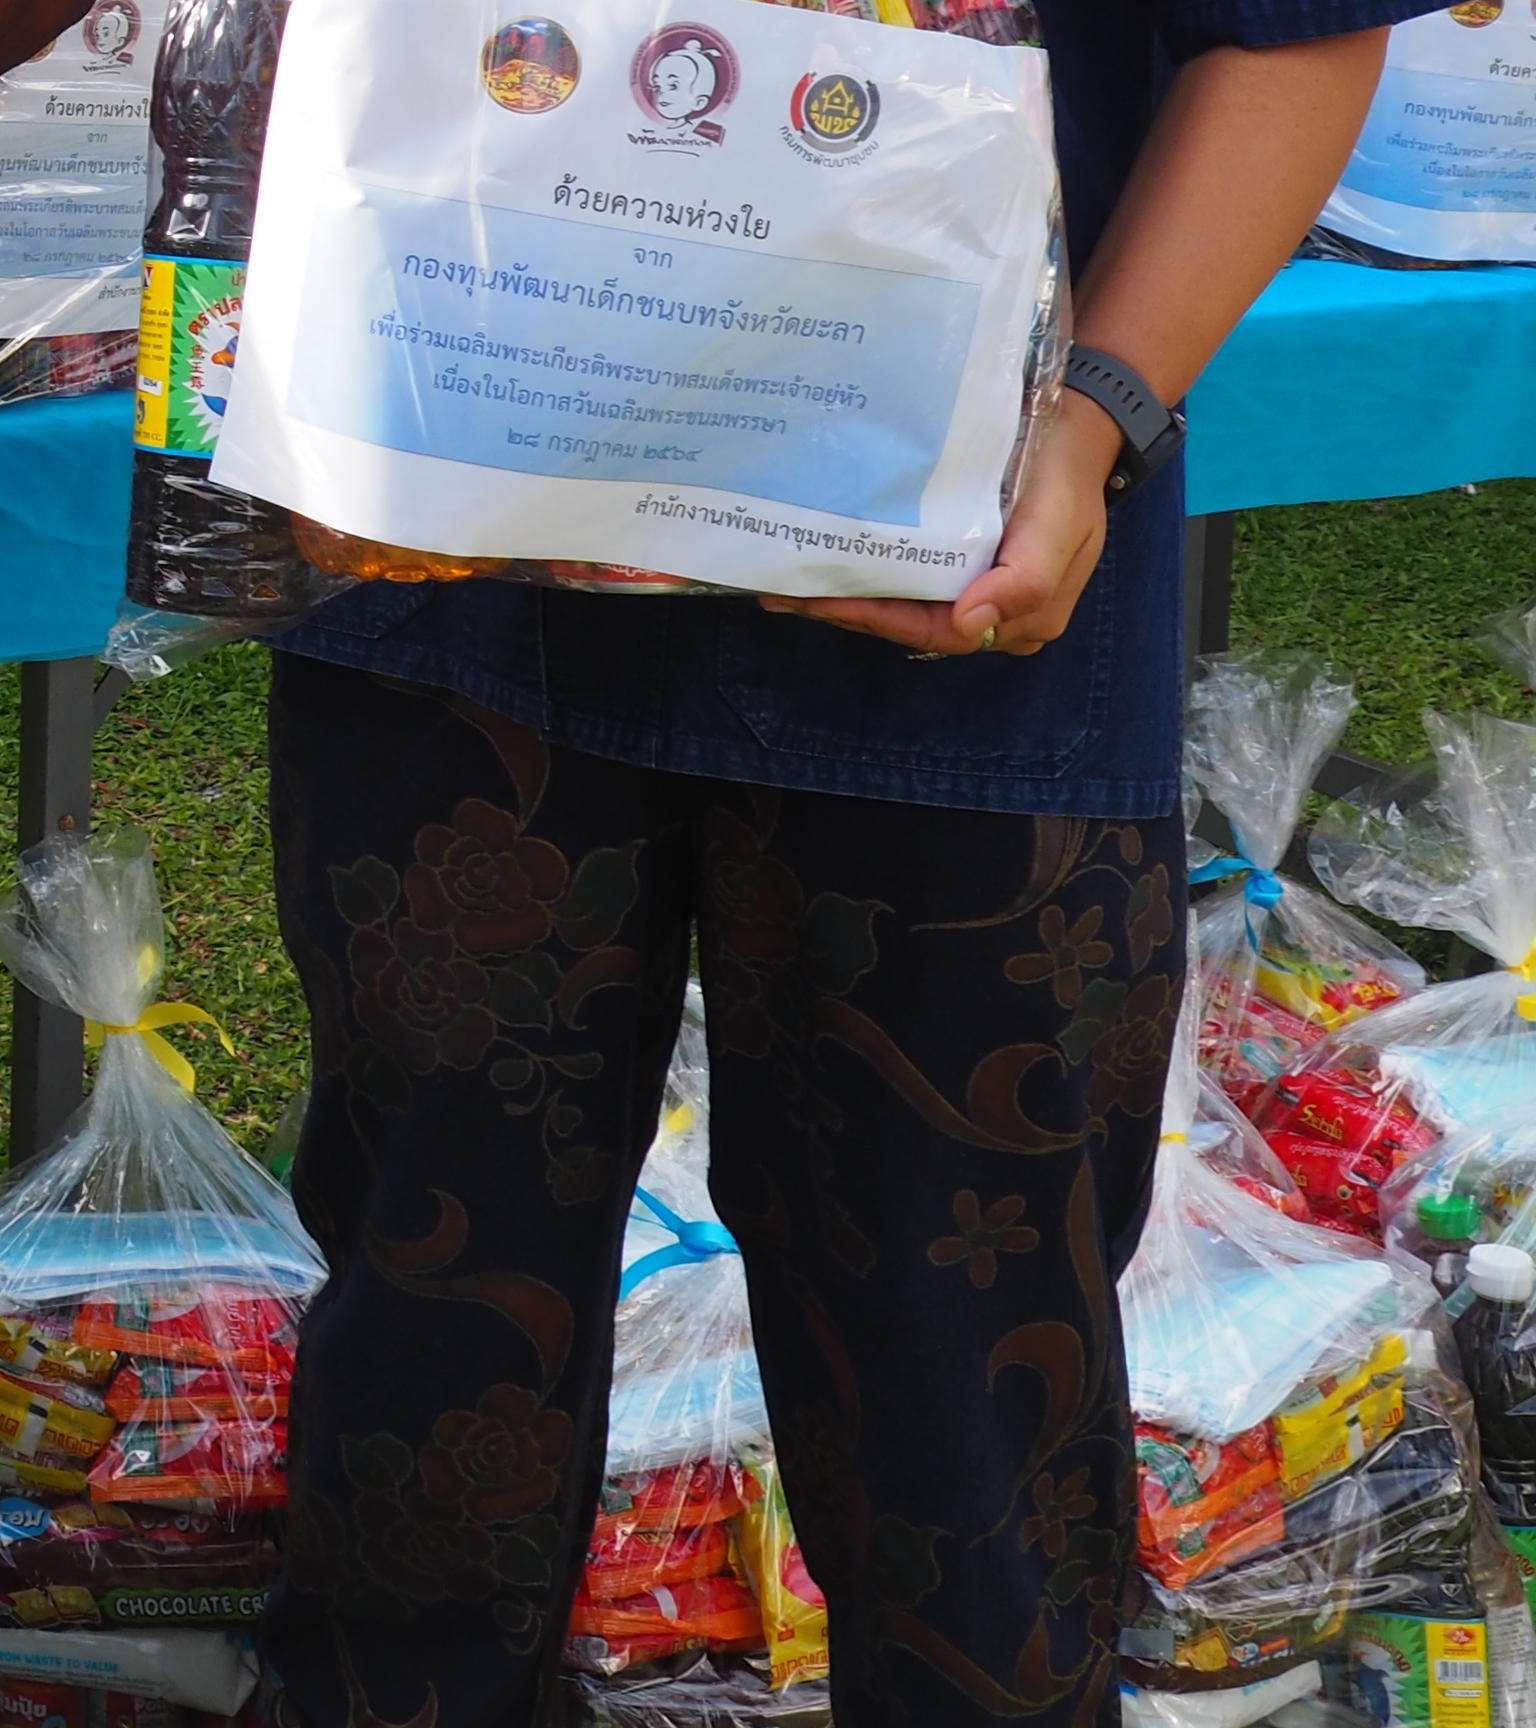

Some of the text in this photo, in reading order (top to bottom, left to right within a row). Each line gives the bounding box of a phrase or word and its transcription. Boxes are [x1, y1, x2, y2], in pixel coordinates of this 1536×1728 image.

[87, 131, 108, 145] จาก
[778, 125, 881, 169] กรมการพัฒนาชุมชน
[552, 178, 772, 241] ด้วยความห่วงใย
[633, 244, 674, 270] จาก
[402, 247, 866, 346] กองทุนพัฒนาเด็กชนบทจังหวัดยะลา
[433, 368, 788, 438] เนื่องในโอกาสวันเฉลิมพระชนมพรรษา
[506, 425, 704, 465] ๒๘ กรกฎาคม ๒๕๖๔
[635, 492, 968, 570] สำนักงานพัฒนาชุมชนจังหวัดยะลา
[115, 1595, 232, 1617] CHOCOLATE
[25, 1652, 62, 1667] WASTE
[66, 1658, 81, 1669] TO
[83, 1660, 120, 1673] VALUE
